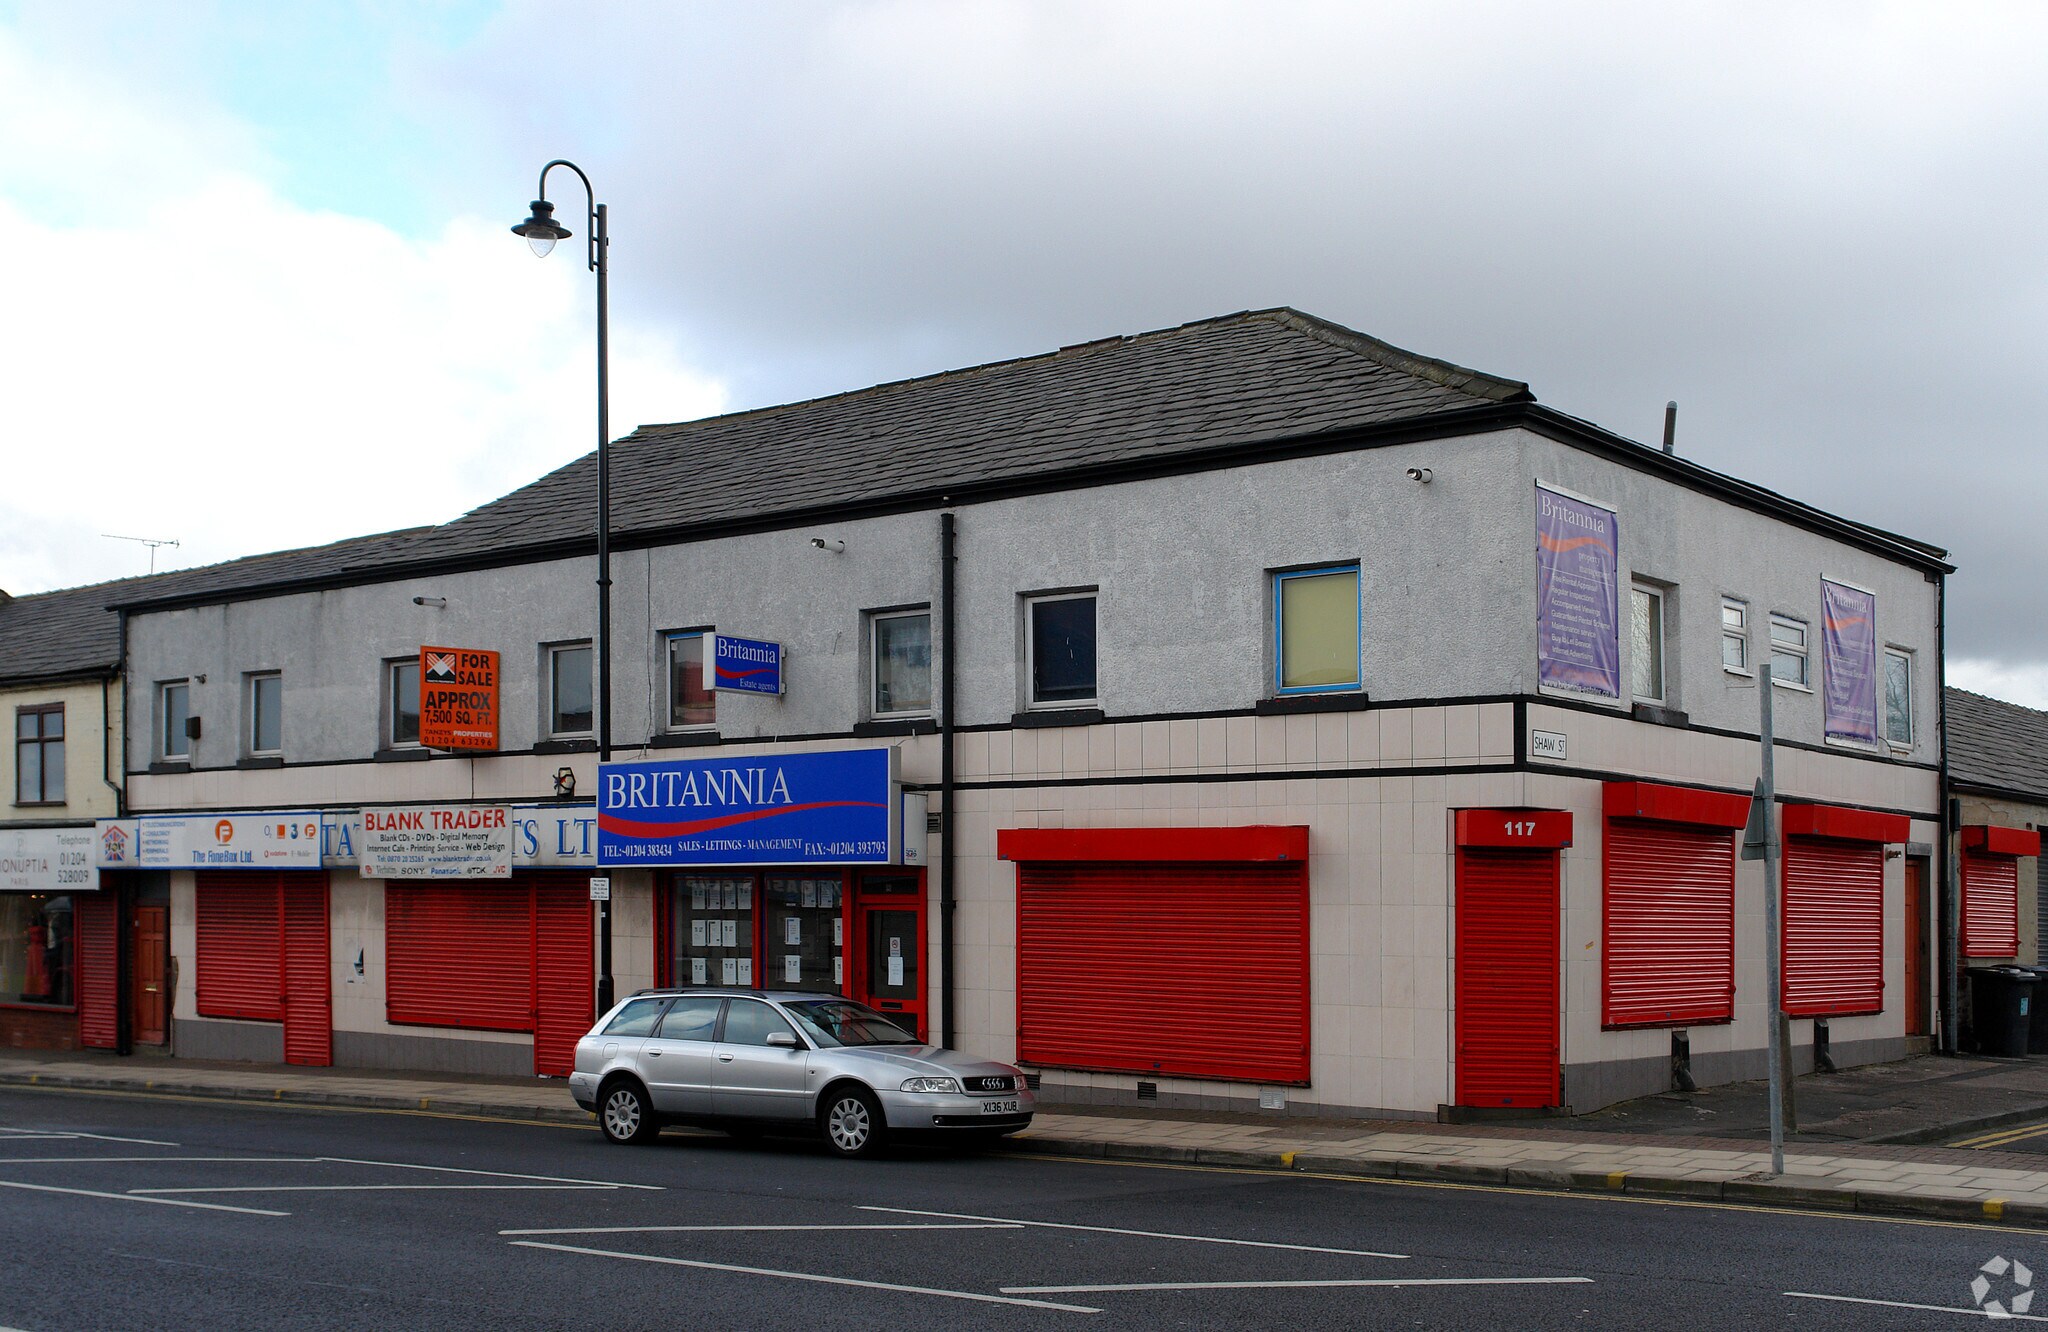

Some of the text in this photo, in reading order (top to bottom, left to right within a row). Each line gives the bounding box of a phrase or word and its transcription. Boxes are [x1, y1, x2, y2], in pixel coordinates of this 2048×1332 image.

[1542, 495, 1604, 533] Britannia
[1570, 590, 1594, 603] Inspections
[717, 637, 776, 664] Britannia
[462, 654, 490, 669] FOR
[458, 671, 492, 686] SALE
[740, 678, 776, 692] Estate agents
[425, 691, 490, 709] APPROX
[425, 709, 492, 725] 7,500 SQ. FT.
[424, 736, 455, 744] 01204
[453, 730, 493, 738] PROPERTIES
[1534, 736, 1555, 752] SHAW
[606, 767, 794, 809] BRITANNIA
[365, 809, 505, 831] BLANK TRADER
[290, 822, 299, 840] 3
[1504, 821, 1536, 836] 117
[56, 834, 91, 847] Telephone
[380, 832, 489, 843] Blank CDs DVDs Digital Memory
[366, 844, 391, 852] Internet
[410, 844, 436, 854] Printing
[437, 844, 460, 852] Service
[466, 842, 482, 851] Web
[483, 842, 506, 852] Design
[647, 844, 672, 857] 383434
[678, 838, 803, 852] SALES LETTINGS MANAGEMENT
[856, 841, 886, 855] 393793
[60, 852, 86, 866] 01204
[192, 850, 255, 863] The FoneBox Ltd.
[0, 858, 49, 873] ONUPTIA
[401, 867, 425, 875] SONY
[472, 866, 486, 874] TDK
[492, 866, 506, 874] JVC
[57, 870, 89, 883] 528009
[983, 1100, 1018, 1113] X136 XUB
